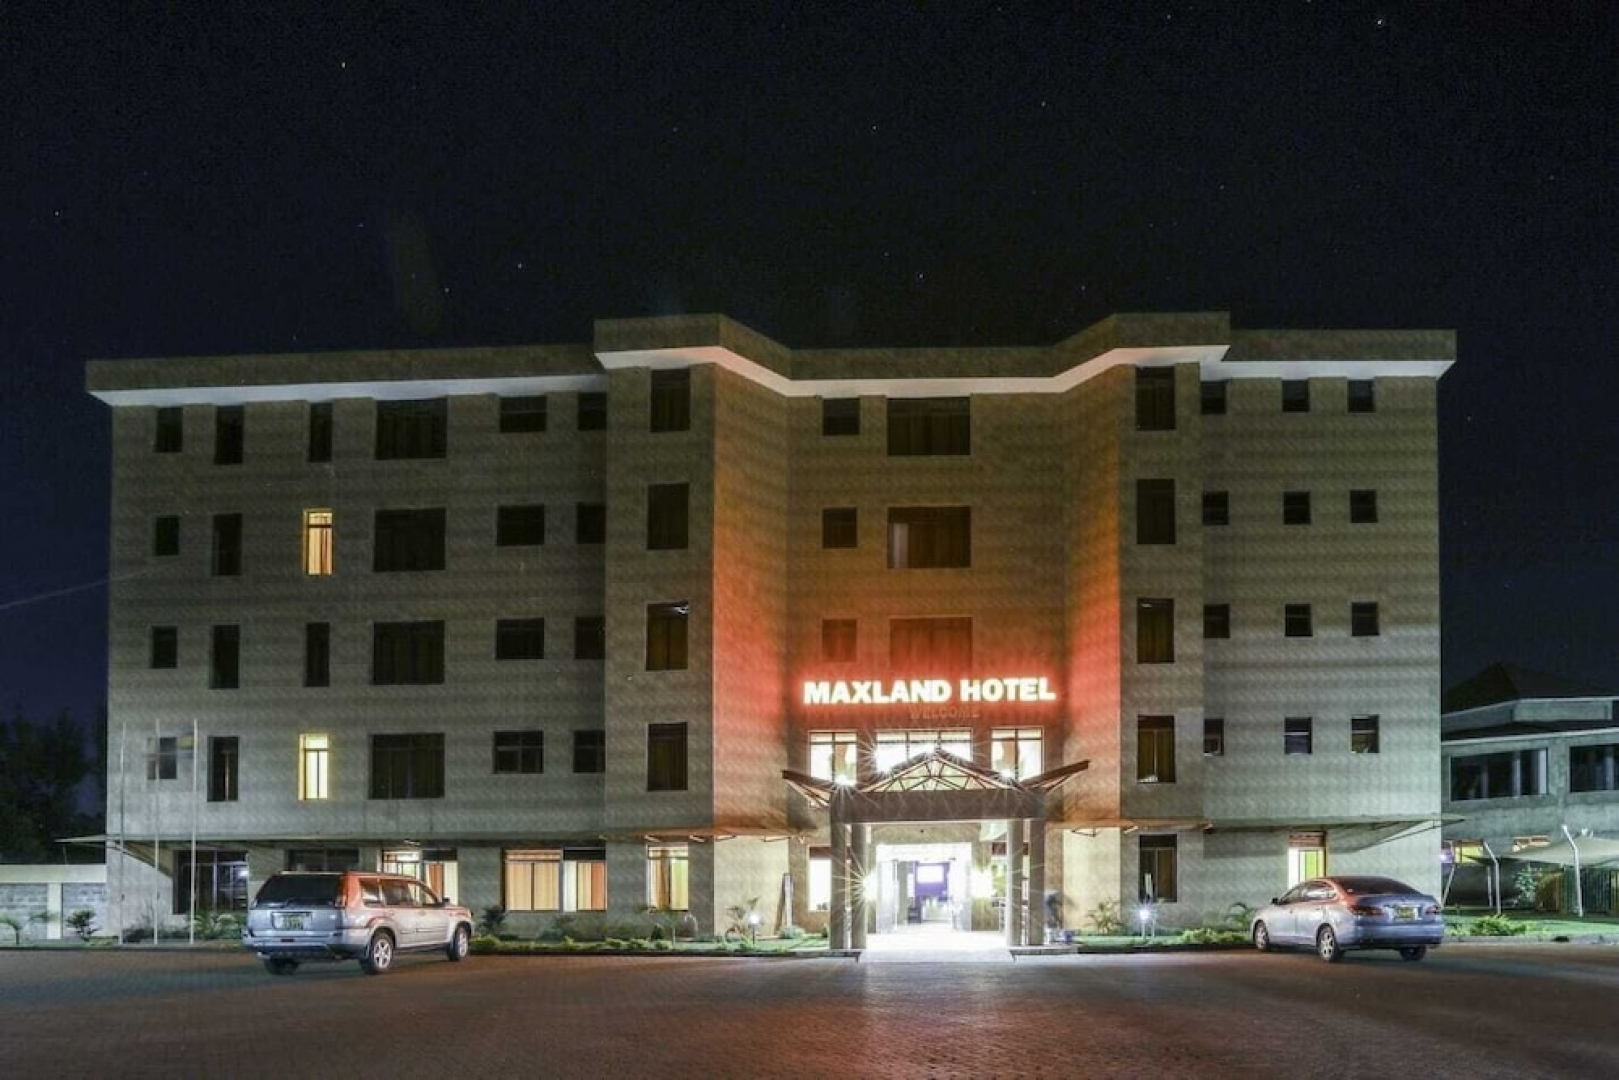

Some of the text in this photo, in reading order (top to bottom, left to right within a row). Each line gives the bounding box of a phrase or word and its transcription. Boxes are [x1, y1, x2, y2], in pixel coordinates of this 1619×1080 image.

[803, 677, 1056, 704] MAXLAND HOTEL
[908, 705, 980, 719] WELCOME
